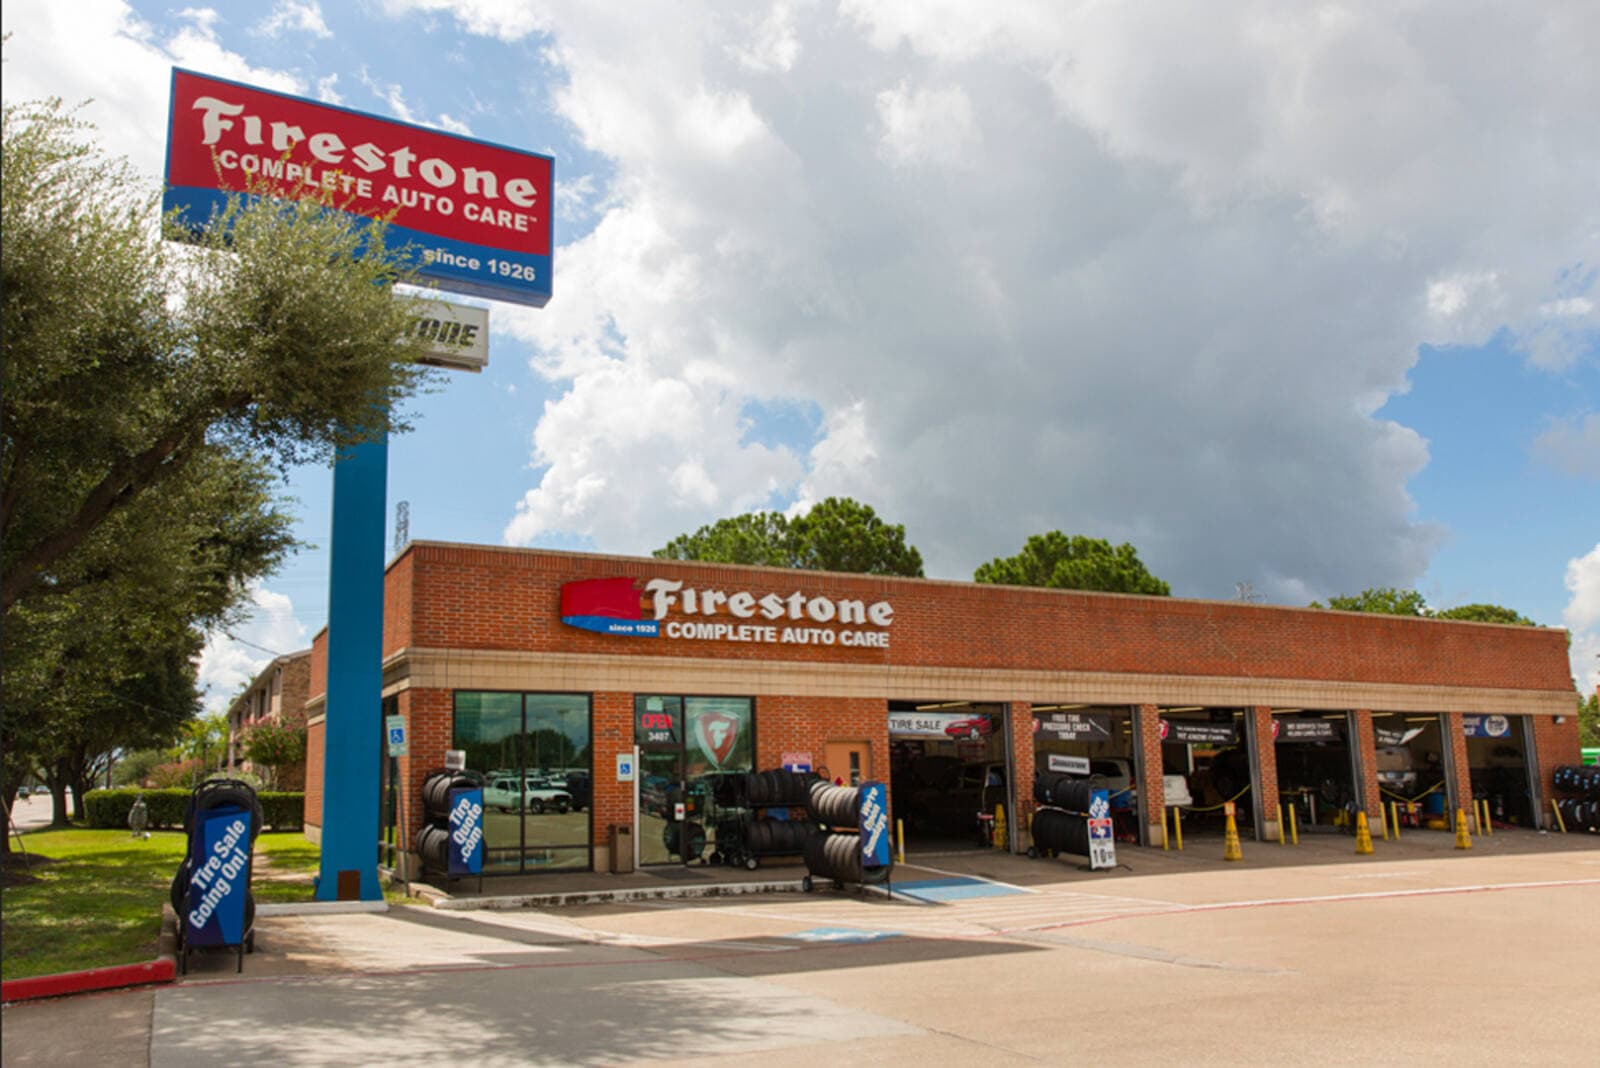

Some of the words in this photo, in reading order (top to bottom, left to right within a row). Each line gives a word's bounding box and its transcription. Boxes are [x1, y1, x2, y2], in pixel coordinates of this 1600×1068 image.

[191, 96, 538, 208] Firestone
[219, 149, 373, 199] COMPLETE
[381, 184, 455, 216] AUTO
[423, 247, 481, 271] since
[487, 258, 537, 282] 1926
[645, 578, 894, 627] Firestone
[608, 623, 634, 633] since
[636, 624, 657, 634] 1926
[666, 621, 777, 643] COMPLETE
[781, 627, 835, 645] AUTO
[839, 630, 890, 648] CARE
[641, 713, 673, 729] OPEN
[889, 718, 913, 730] TIRE
[915, 719, 942, 730] SALE
[449, 797, 471, 827] Tire
[452, 803, 483, 846] Quote
[191, 855, 222, 891] Tire
[213, 819, 246, 859] Sale
[461, 826, 483, 864] .com
[189, 877, 231, 929] Going
[220, 847, 249, 881] On!
